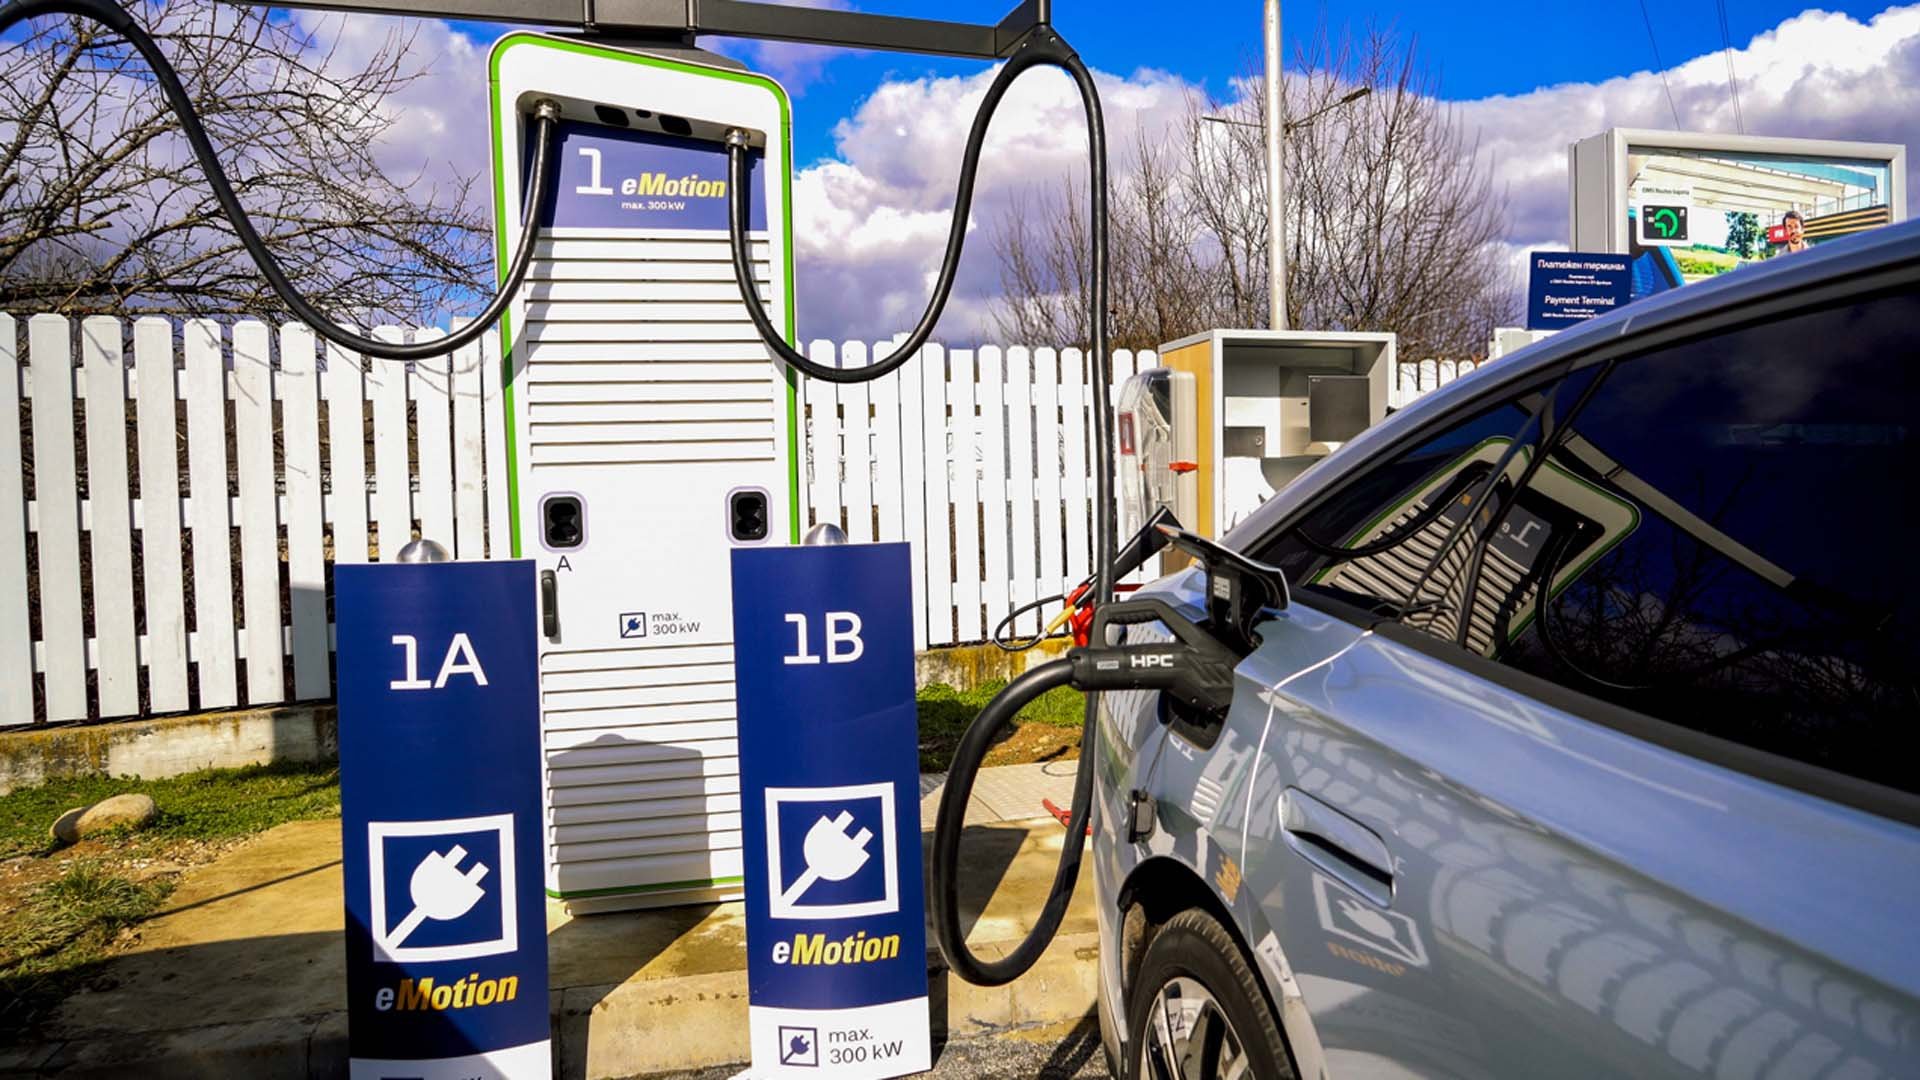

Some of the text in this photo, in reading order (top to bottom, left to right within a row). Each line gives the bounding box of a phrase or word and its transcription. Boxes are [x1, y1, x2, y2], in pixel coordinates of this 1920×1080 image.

[576, 147, 726, 198] 1 eMotion
[621, 202, 685, 211] max. 300 kW
[1544, 295, 1616, 306] Payment Terminal
[556, 554, 572, 572] A
[652, 612, 683, 621] max.
[653, 622, 701, 635] 300 kW
[784, 611, 864, 665] 1B
[390, 632, 489, 690] 1A
[1130, 654, 1174, 668] HPC
[772, 931, 900, 965] eMotion
[375, 972, 519, 1012] eMotion
[829, 1028, 874, 1042] max.
[830, 1040, 904, 1064] 300 kW
